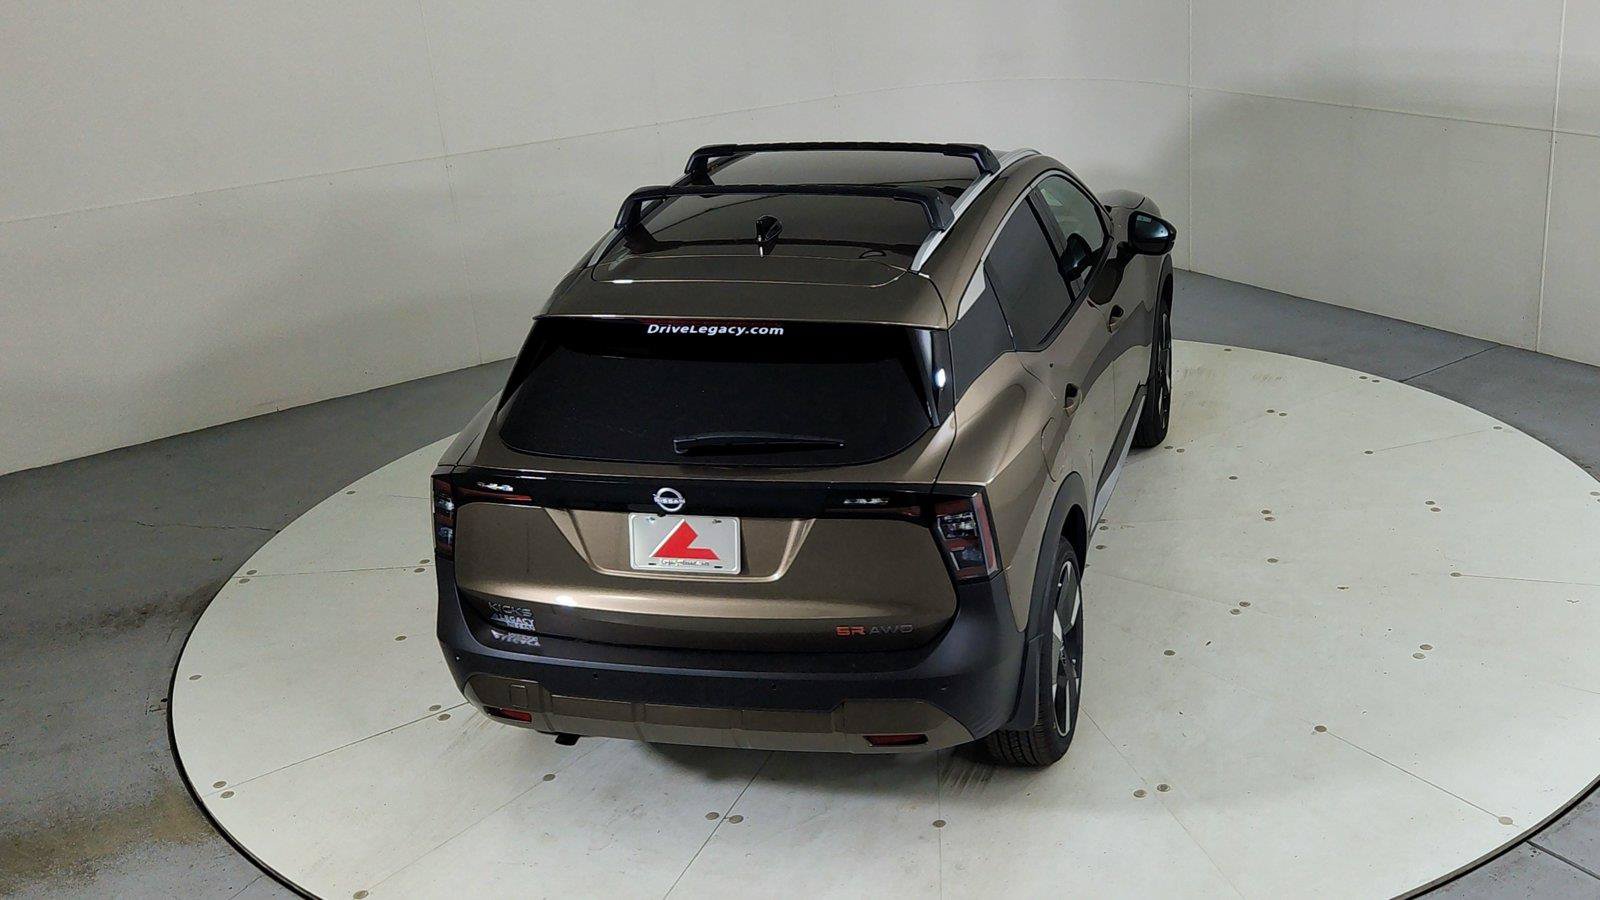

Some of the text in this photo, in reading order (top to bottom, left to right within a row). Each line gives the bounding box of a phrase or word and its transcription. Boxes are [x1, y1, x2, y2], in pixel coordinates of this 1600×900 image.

[647, 323, 784, 336] DriveLegacy.com
[488, 601, 533, 618] KICKS
[499, 613, 535, 627] LEGACY
[836, 623, 914, 636] SR AWD
